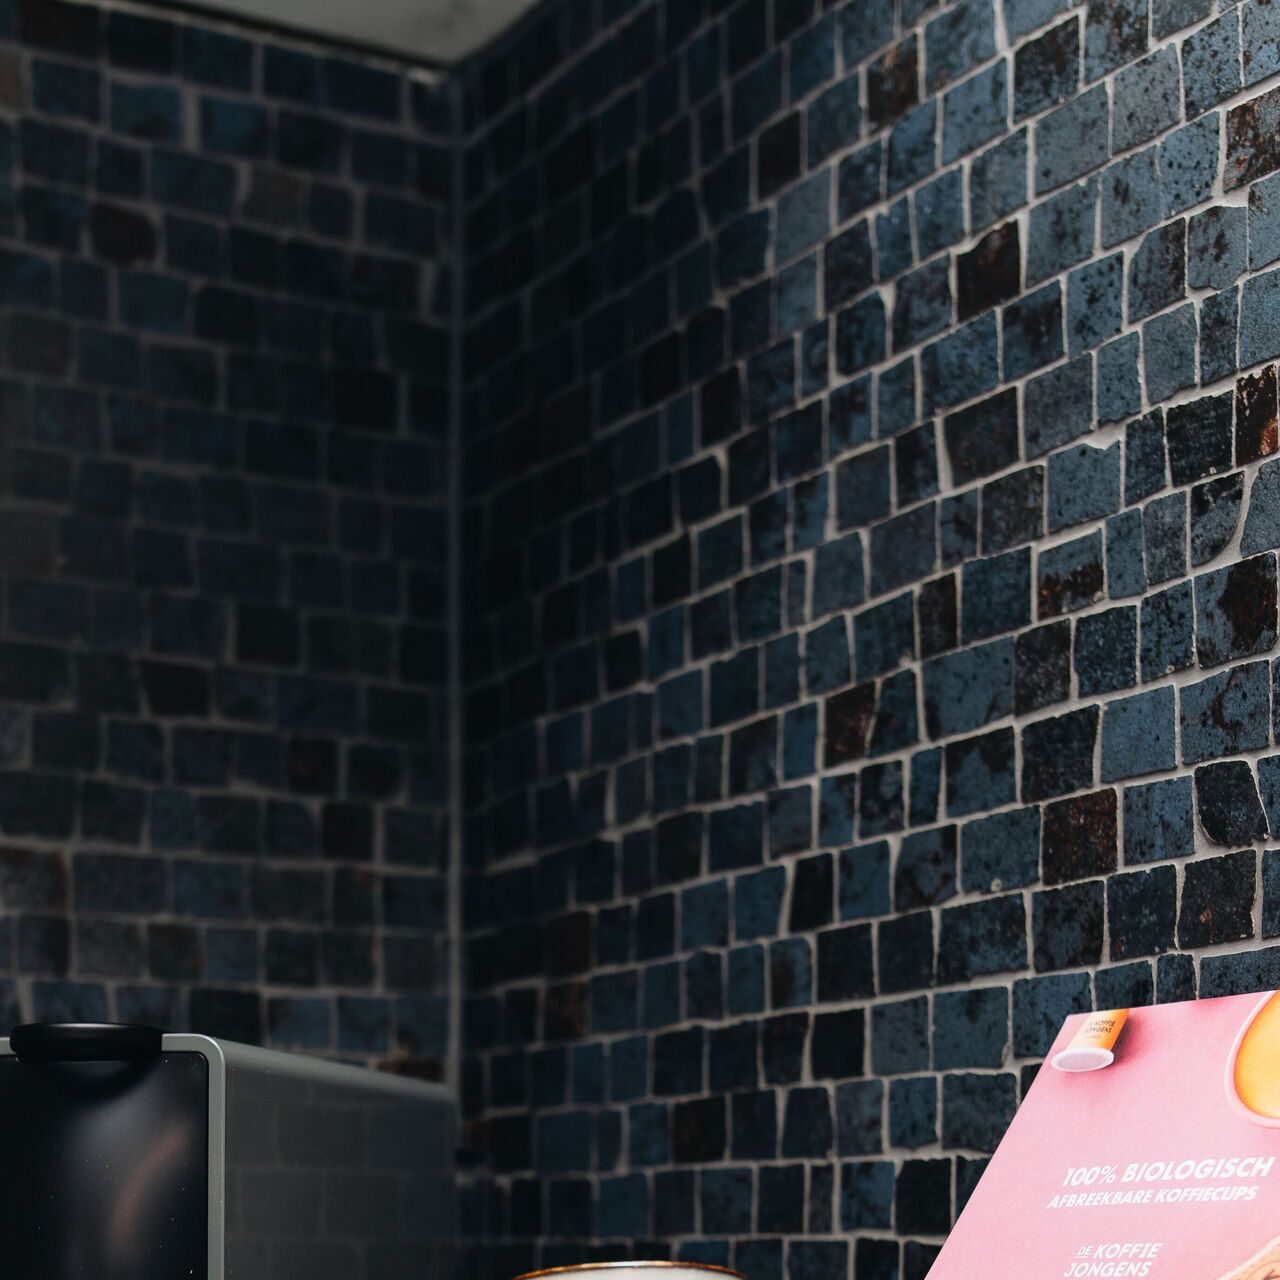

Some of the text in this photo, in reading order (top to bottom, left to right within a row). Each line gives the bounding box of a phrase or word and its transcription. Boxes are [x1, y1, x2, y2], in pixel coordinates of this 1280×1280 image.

[1063, 1157, 1276, 1187] 100% BIOLOGISCH
[1047, 1185, 1259, 1209] AFBREEKBARE KOFFIECUPS
[1076, 1243, 1163, 1259] DE KOFFIE
[1063, 1261, 1152, 1278] JONGENS
